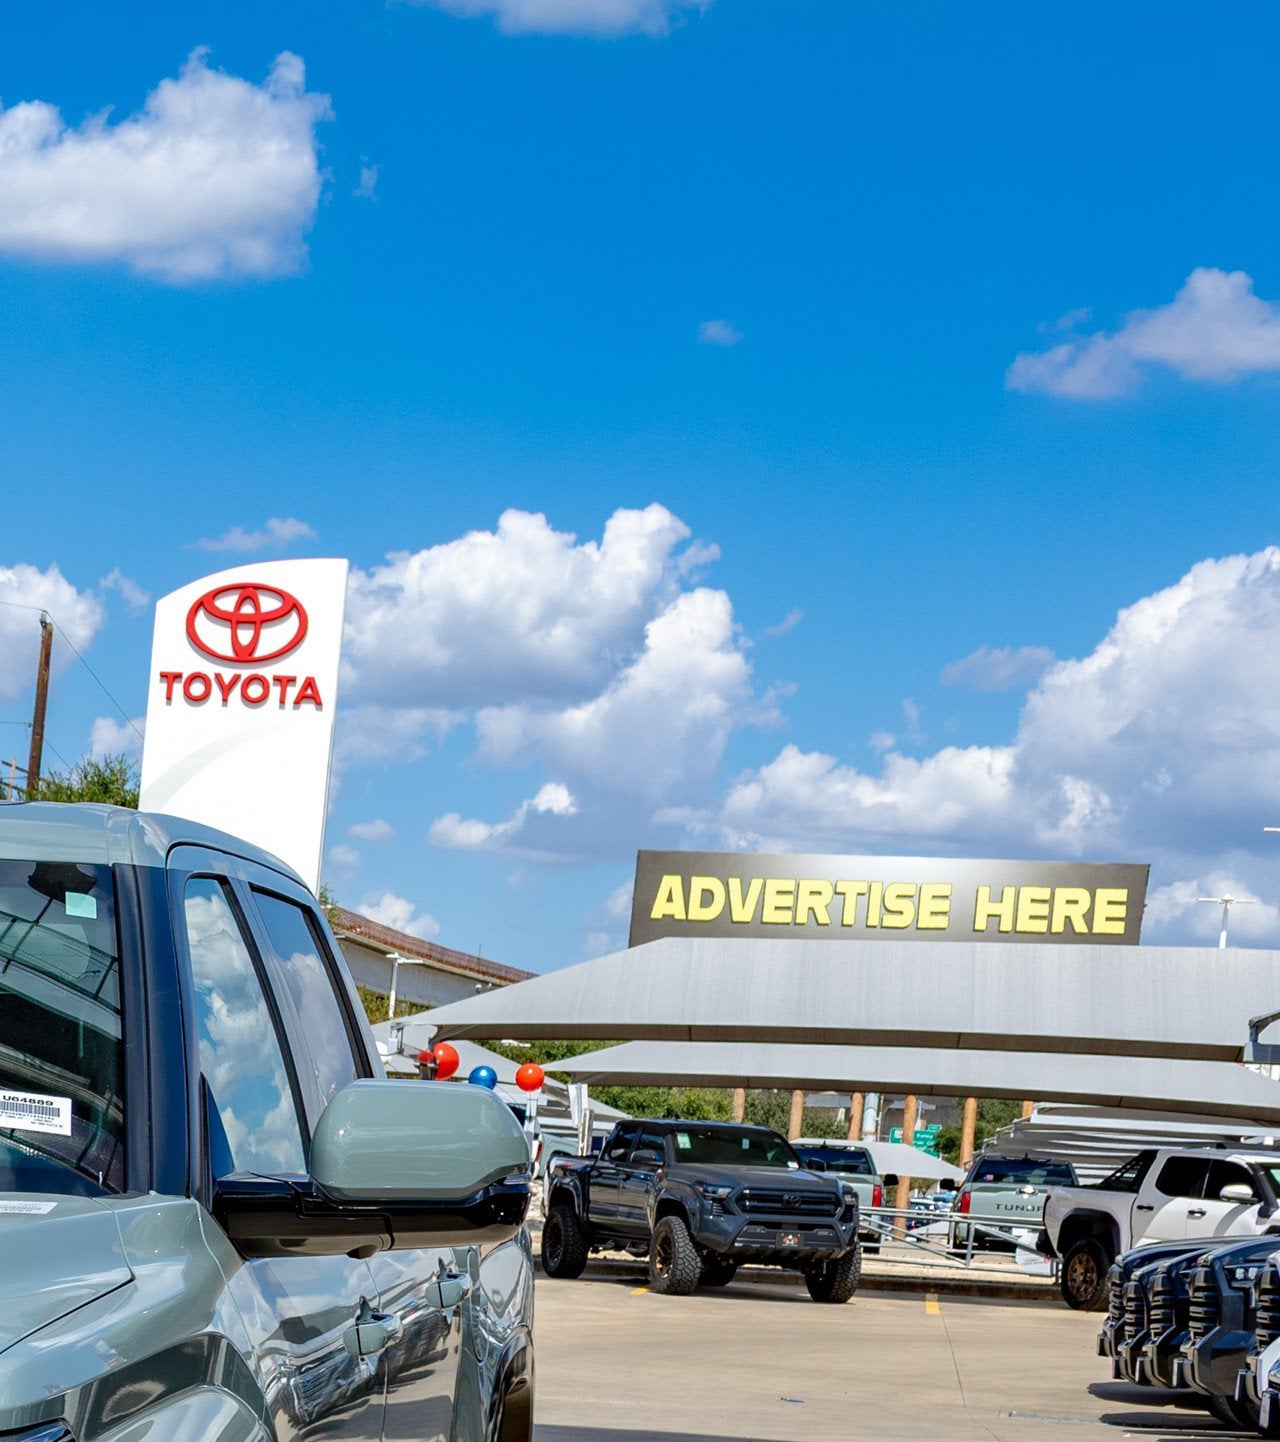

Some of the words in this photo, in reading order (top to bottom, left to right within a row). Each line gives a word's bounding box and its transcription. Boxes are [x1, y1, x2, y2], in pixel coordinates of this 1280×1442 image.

[160, 671, 323, 708] TOYOTA
[650, 874, 953, 930] ADVERTISE
[974, 886, 1129, 936] HERE
[994, 1203, 1043, 1212] TUND
